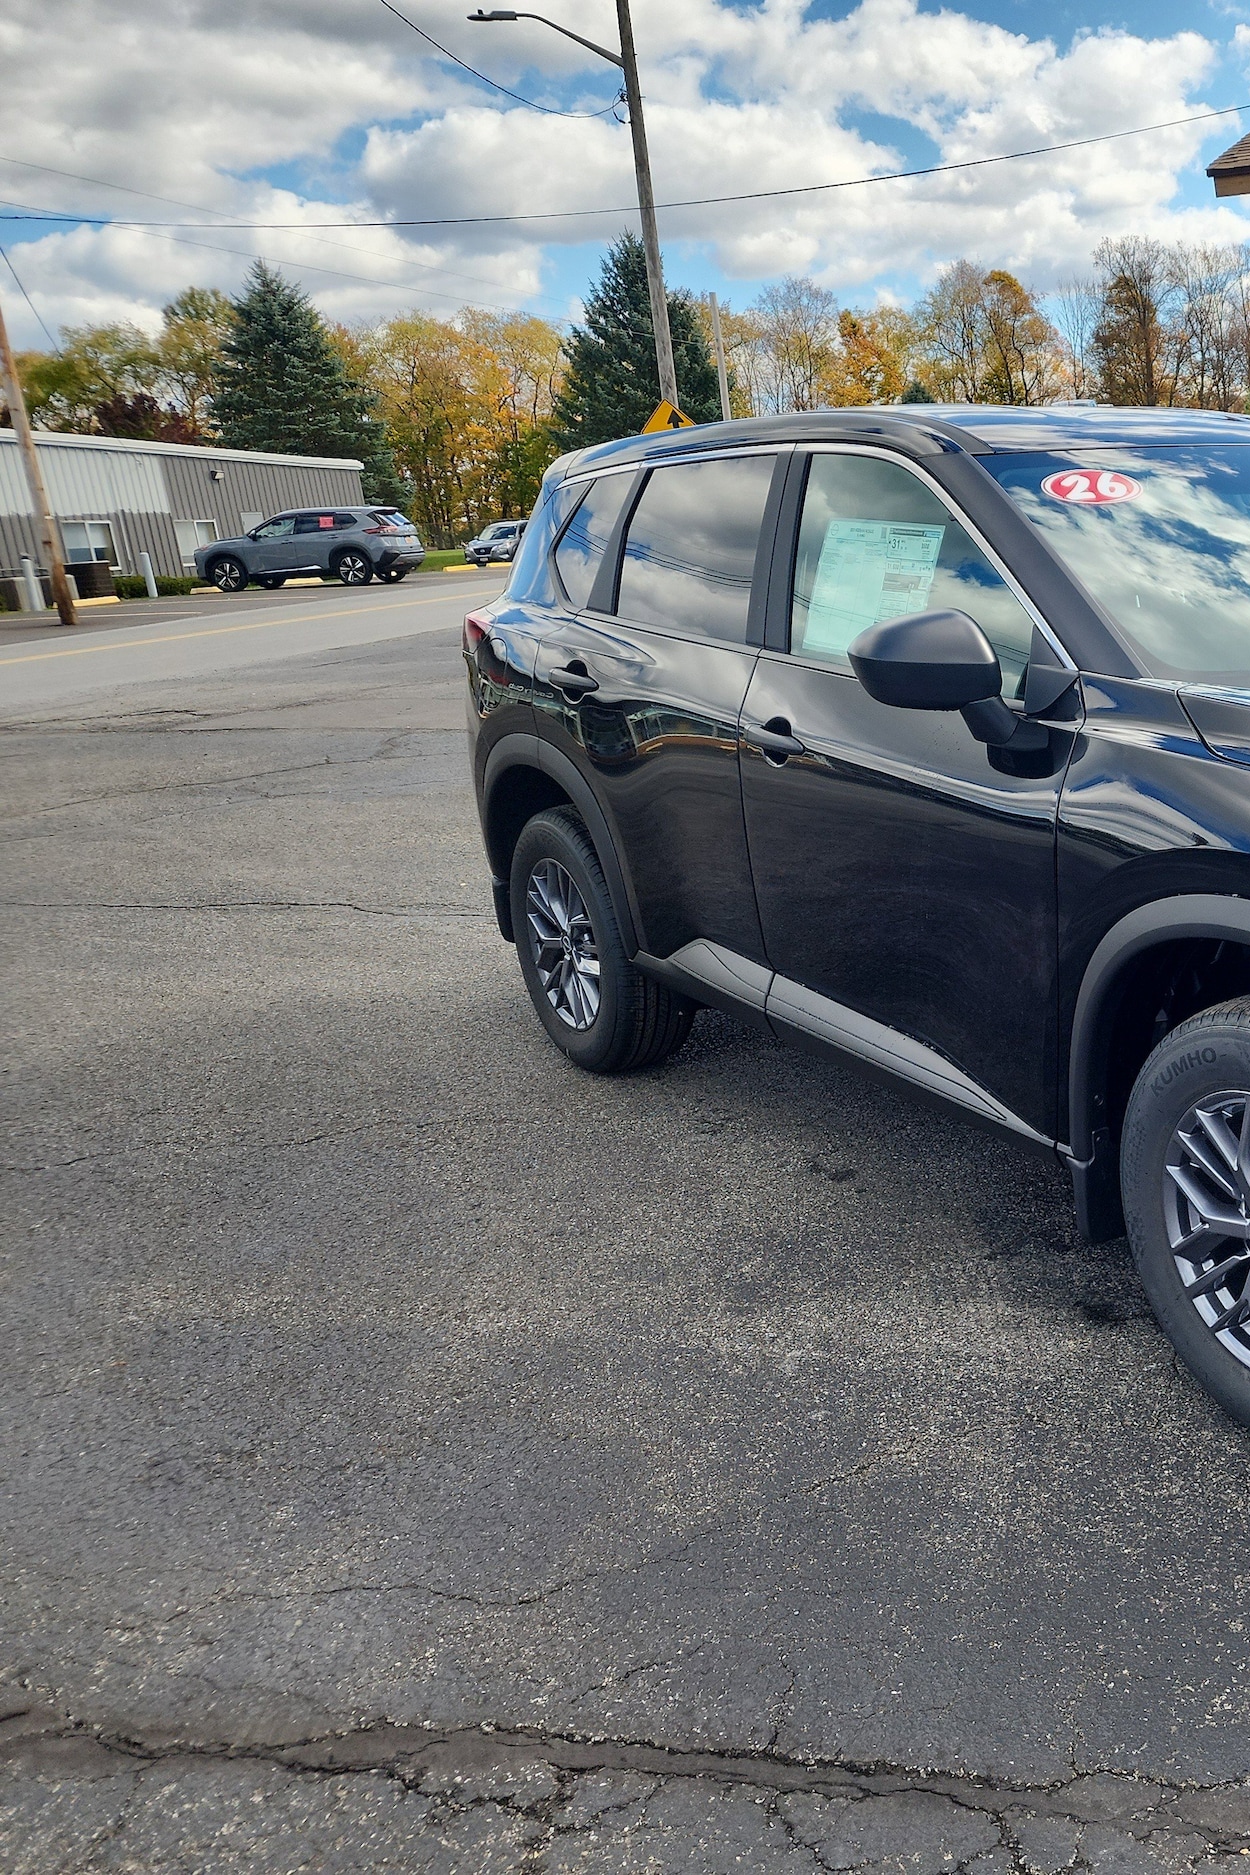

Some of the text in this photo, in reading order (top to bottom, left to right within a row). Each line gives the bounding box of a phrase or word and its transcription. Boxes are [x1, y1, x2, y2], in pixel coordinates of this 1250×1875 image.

[1061, 472, 1128, 501] 26
[891, 538, 901, 550] 31
[1149, 1047, 1217, 1097] KUMHO
